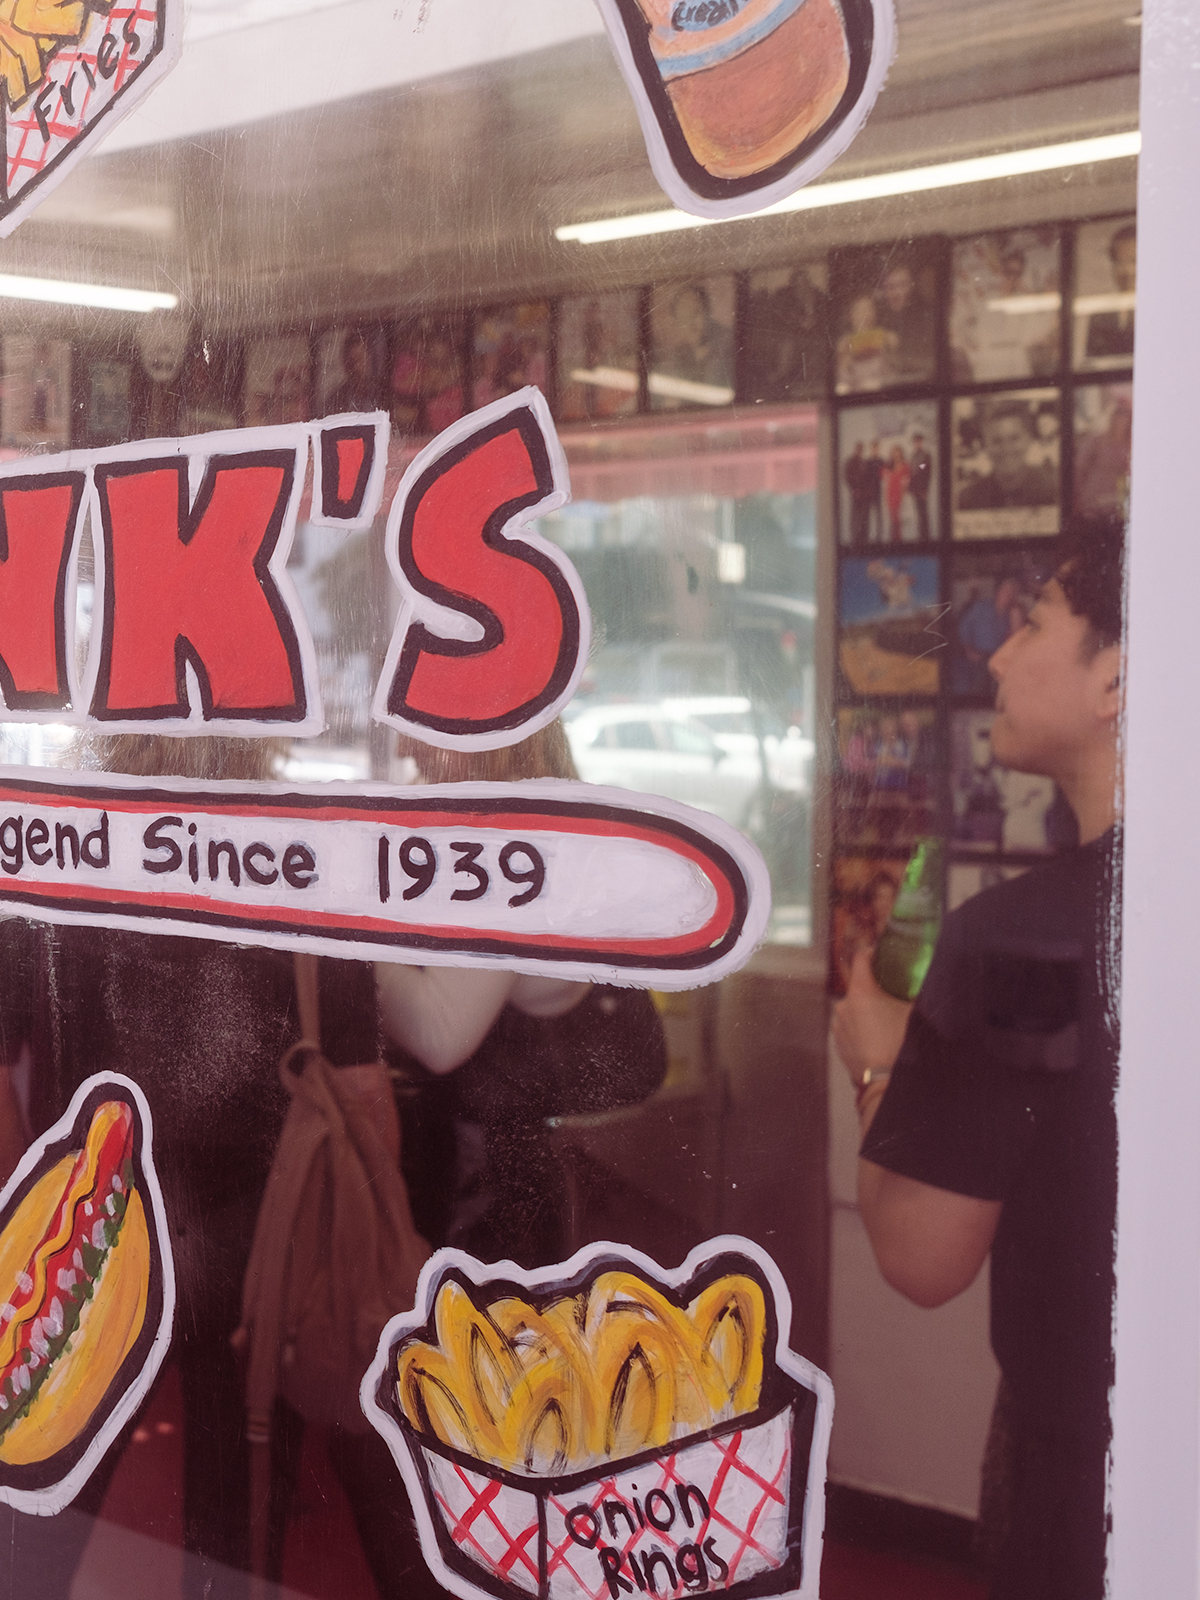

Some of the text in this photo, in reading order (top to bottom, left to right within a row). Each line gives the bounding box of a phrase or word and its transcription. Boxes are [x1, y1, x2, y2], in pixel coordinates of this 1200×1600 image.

[33, 10, 140, 143] Fries
[142, 815, 319, 888] Since
[377, 834, 547, 908] 1939
[598, 1536, 729, 1599] Rings
